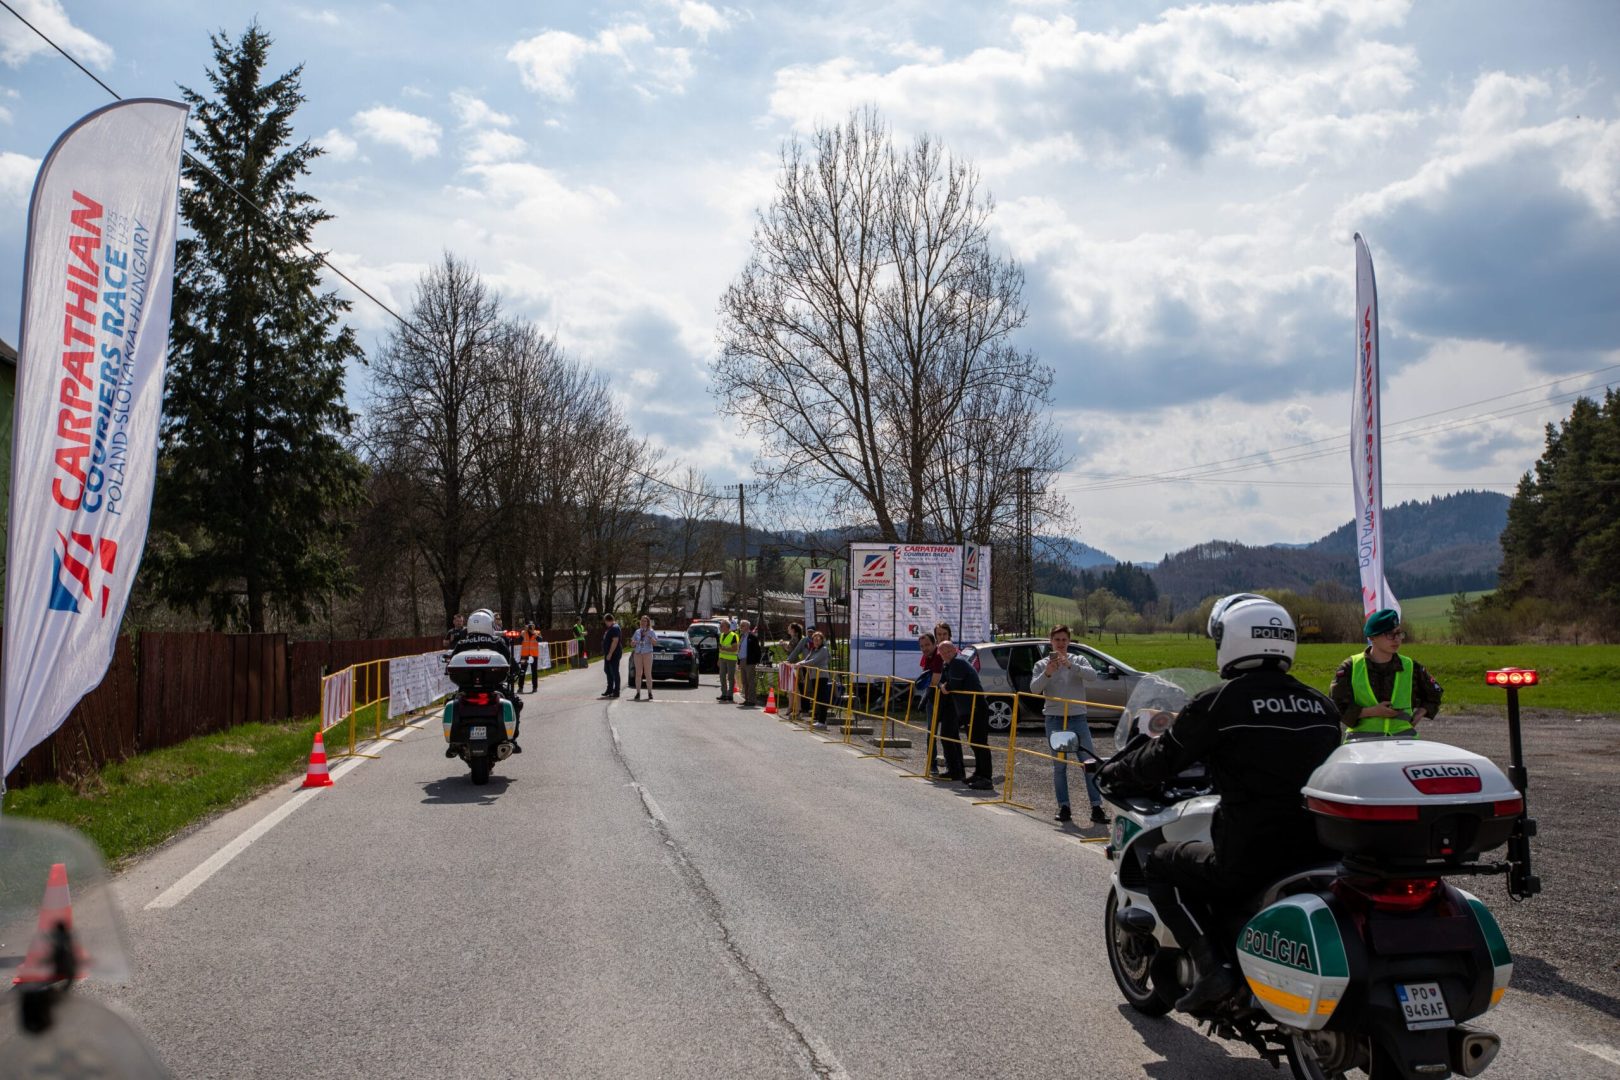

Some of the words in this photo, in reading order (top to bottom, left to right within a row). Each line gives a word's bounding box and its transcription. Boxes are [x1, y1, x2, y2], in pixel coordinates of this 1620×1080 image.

[106, 208, 118, 241] 1975
[102, 244, 128, 338] RACE
[51, 190, 104, 511] CARPATHIAN
[83, 343, 122, 513] COURIERS
[1252, 695, 1326, 715] POLÍCIA
[1410, 765, 1475, 779] POLÍCIA
[1244, 926, 1312, 970] POLÍCIA
[1405, 1002, 1444, 1018] 946AF
[1411, 987, 1428, 1001] PO
